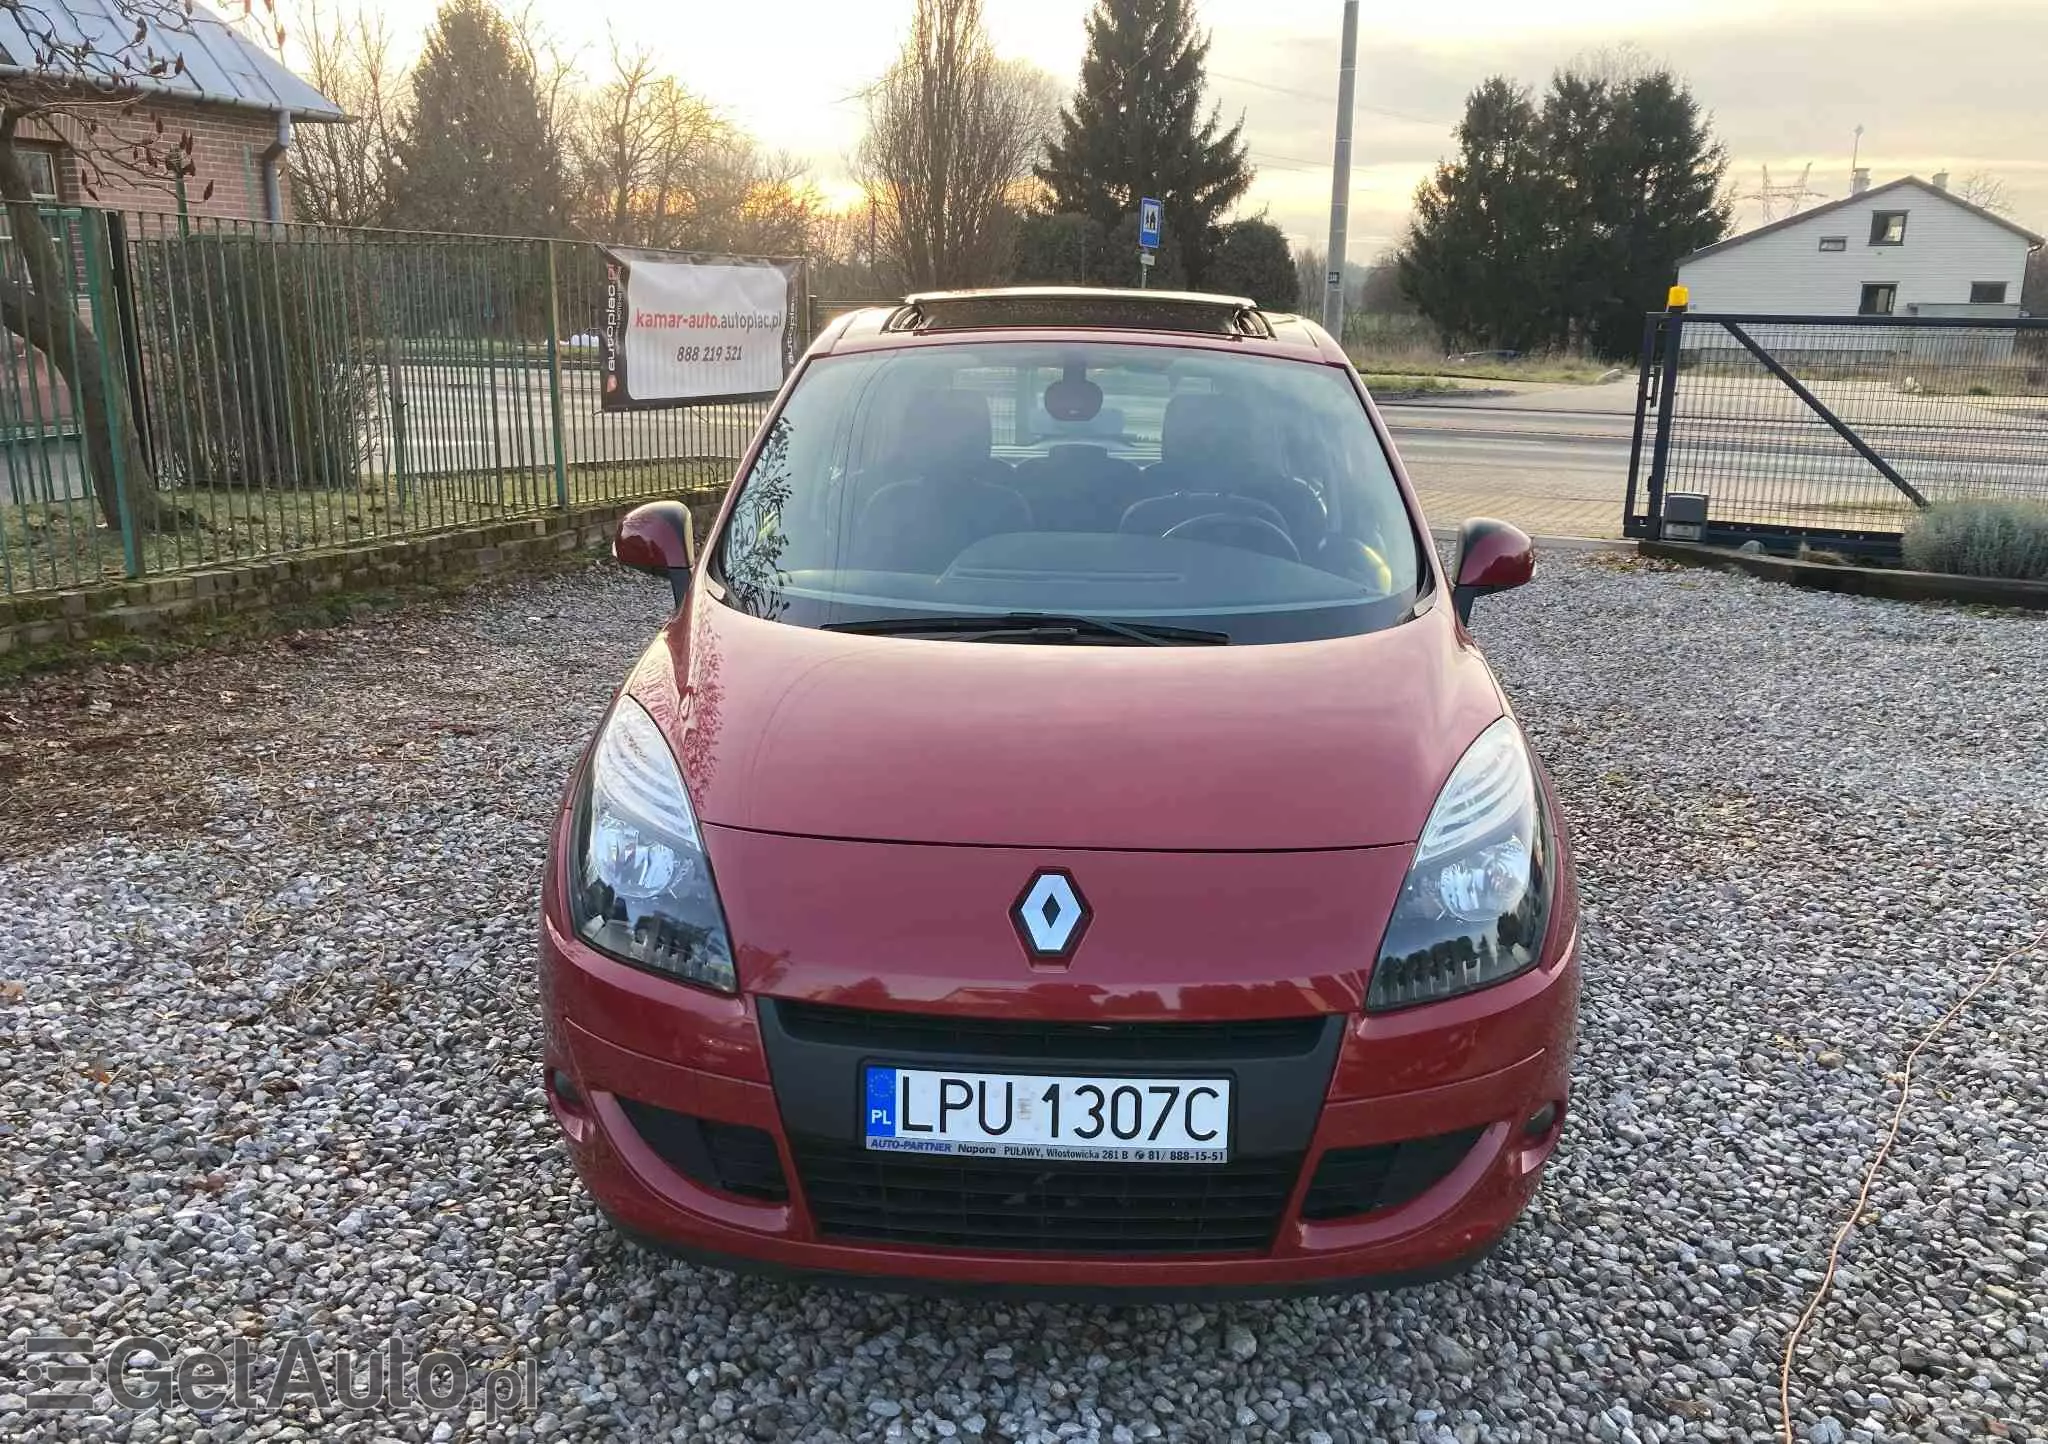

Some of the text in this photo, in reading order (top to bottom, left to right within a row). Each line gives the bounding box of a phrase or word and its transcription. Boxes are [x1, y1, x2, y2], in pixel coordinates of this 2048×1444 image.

[607, 264, 620, 371] autoplac.pl
[636, 308, 782, 333] kamar-auto.autoplac.pl
[676, 346, 700, 362] 888
[702, 346, 722, 362] 219
[871, 1110, 892, 1125] PL
[902, 1075, 1220, 1142] LPU 1307C
[870, 1139, 952, 1153] AUTO-PARTNER
[1121, 1150, 1129, 1160] B
[1170, 1150, 1224, 1162] 888-15-51
